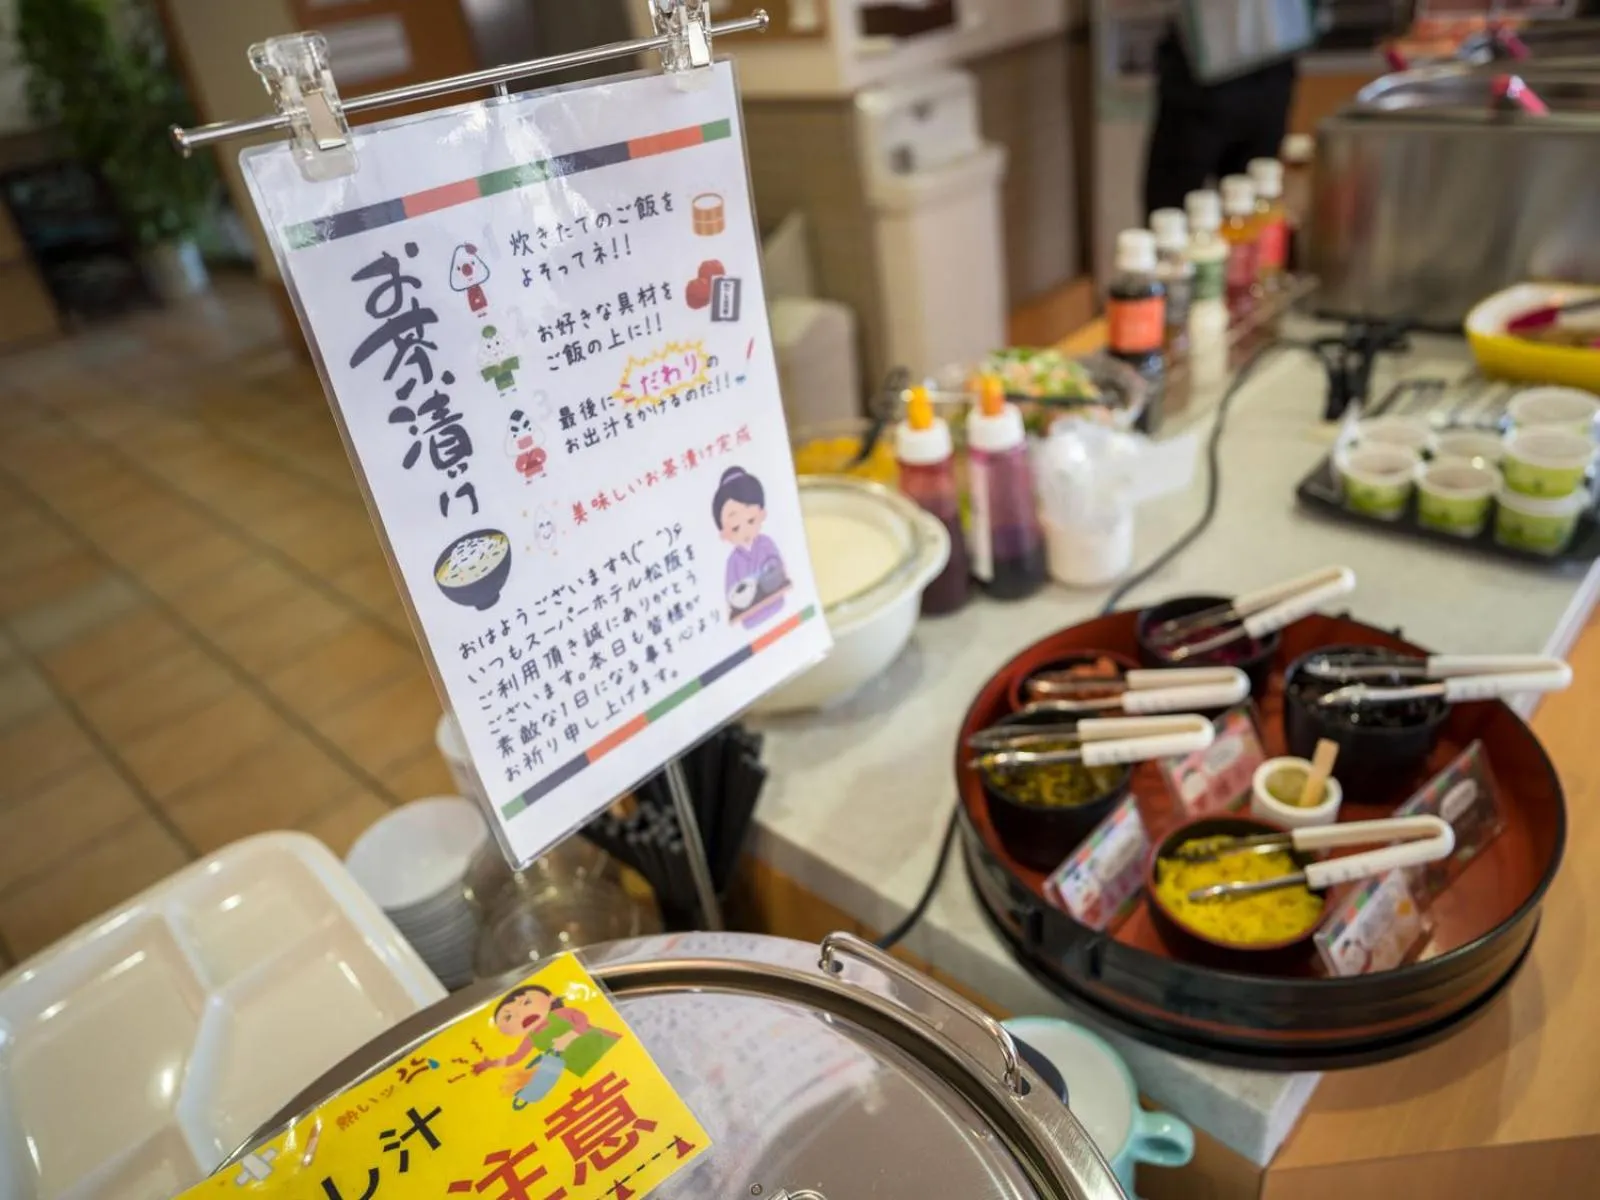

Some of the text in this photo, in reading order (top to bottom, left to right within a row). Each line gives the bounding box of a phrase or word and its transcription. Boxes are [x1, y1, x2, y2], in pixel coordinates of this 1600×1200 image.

[510, 192, 674, 257] 炊きたてのご飯を
[537, 281, 673, 343] お好きな具材を
[349, 242, 479, 518] お茶漬け
[572, 425, 752, 525] 美味しいお茶漬け完成
[467, 544, 697, 684] いつもスーパーホテル松阪を
[478, 570, 698, 711] ご利用頂き誠にありがとう
[488, 594, 702, 735] ございます。本日も皆様が
[504, 668, 678, 783] お祈り申し上げます。
[446, 1071, 659, 1200] 注意
